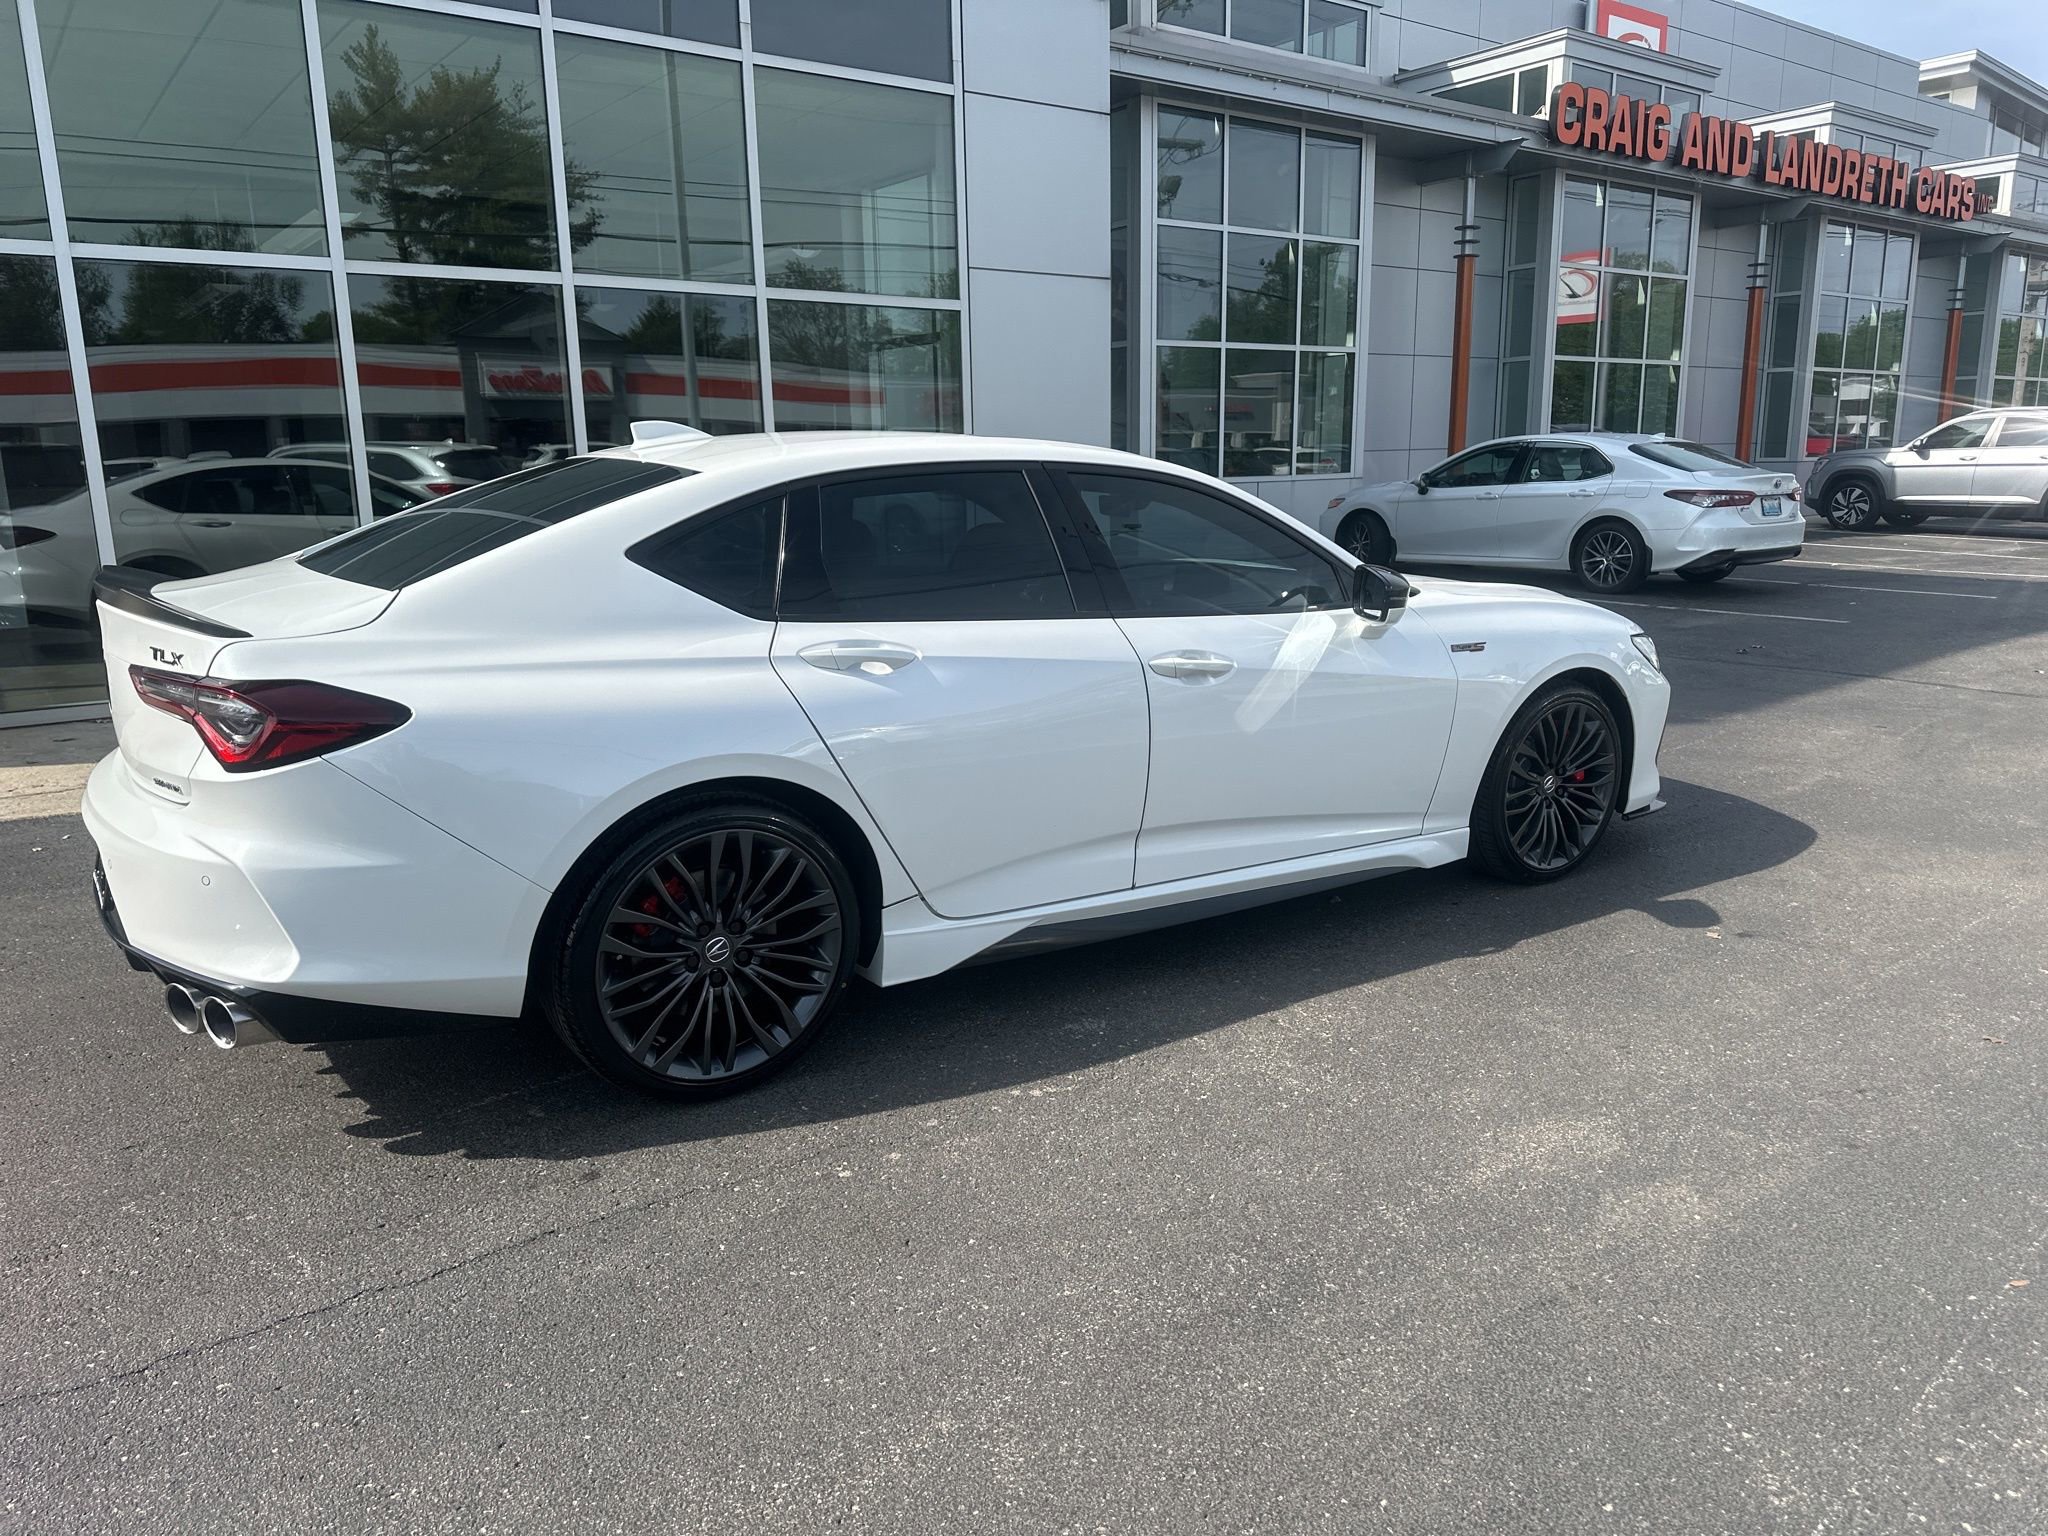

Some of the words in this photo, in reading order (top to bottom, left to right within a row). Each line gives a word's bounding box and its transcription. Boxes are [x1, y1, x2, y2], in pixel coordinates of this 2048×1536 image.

[1556, 82, 1671, 162] CRAIG
[1681, 111, 1754, 177] AND
[1764, 130, 1909, 209] LANDRETH
[1917, 166, 1976, 222] CARS
[149, 646, 185, 669] TLX
